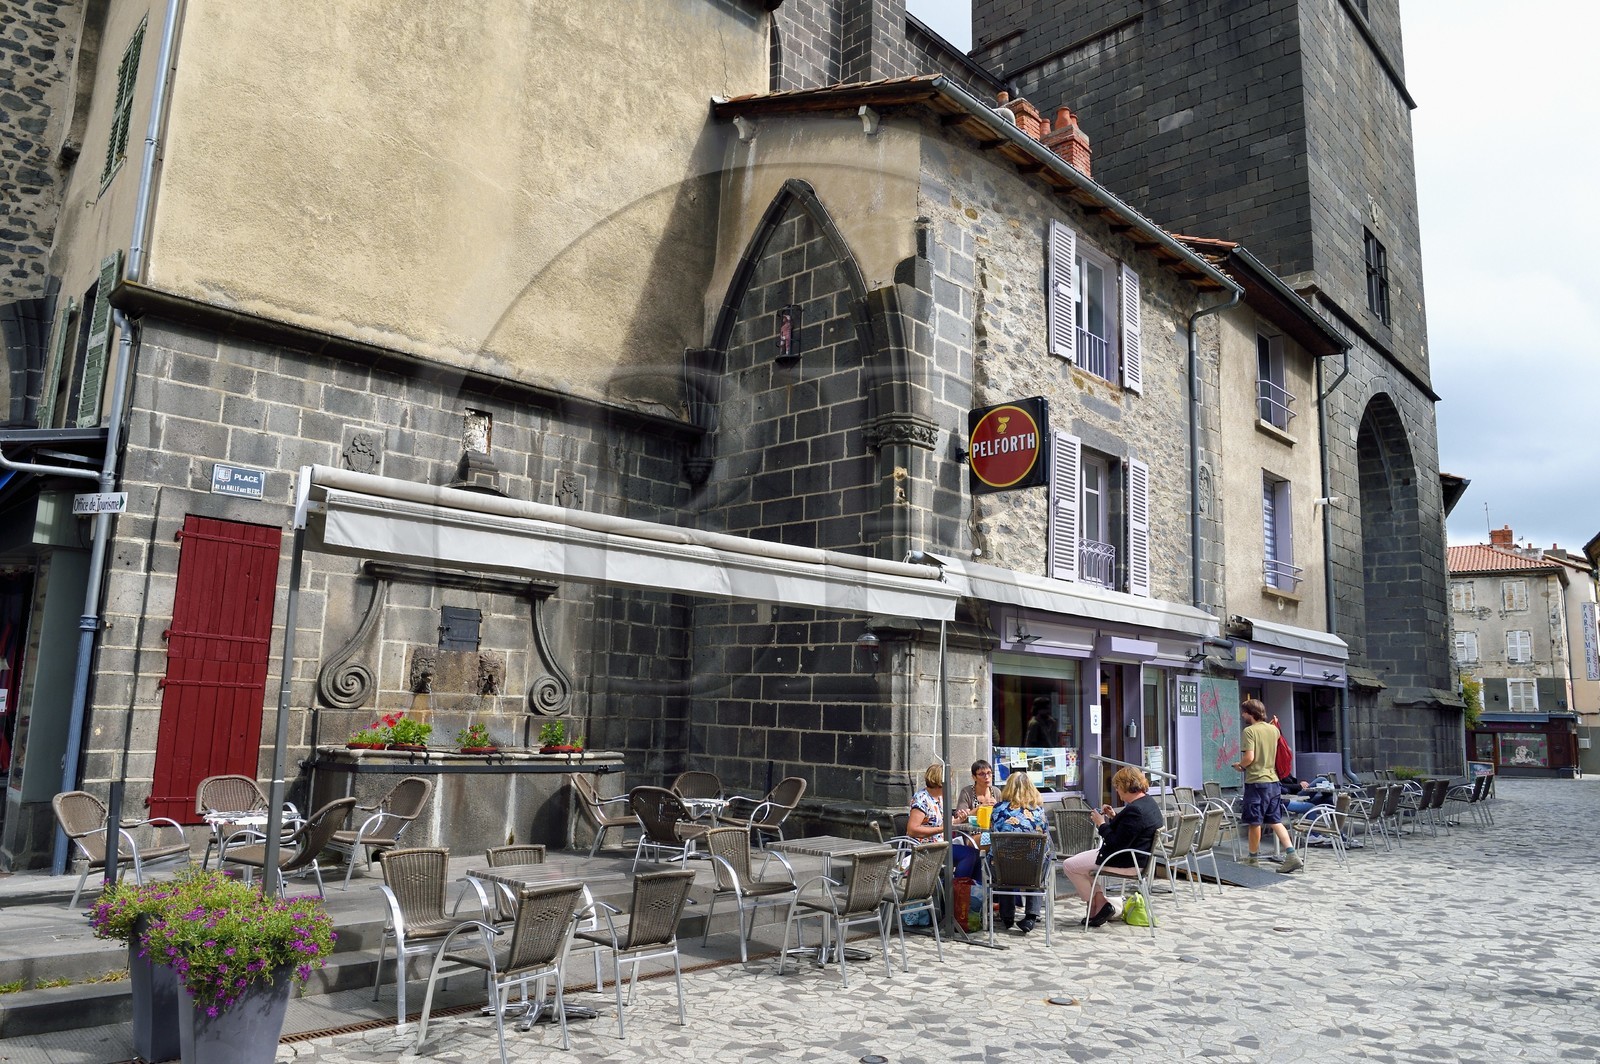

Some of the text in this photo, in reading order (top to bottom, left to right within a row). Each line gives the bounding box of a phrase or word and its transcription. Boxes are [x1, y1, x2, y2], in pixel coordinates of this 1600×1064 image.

[972, 432, 1036, 459] PELFORTH
[234, 473, 259, 484] PLACE
[74, 498, 88, 511] Office
[89, 497, 96, 511] de
[1583, 605, 1592, 679] PARFUMERIE
[1181, 685, 1196, 694] CAFE
[1181, 705, 1197, 713] HALLE
